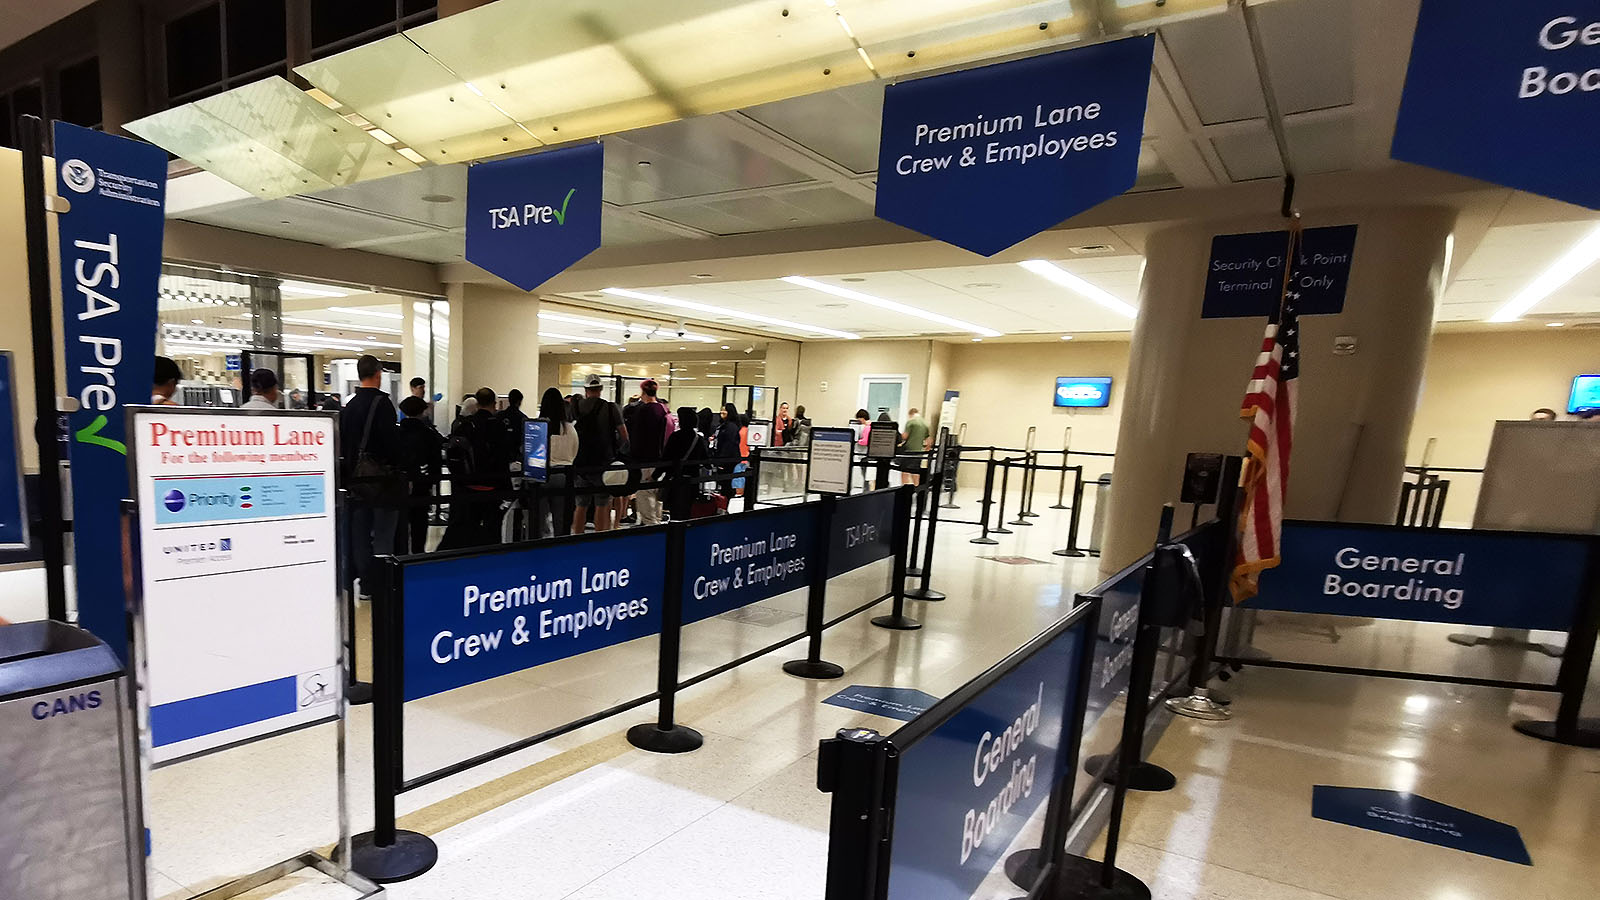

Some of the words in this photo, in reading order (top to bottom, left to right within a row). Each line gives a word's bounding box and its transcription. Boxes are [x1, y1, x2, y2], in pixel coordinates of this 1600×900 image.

[915, 114, 1023, 146] Premium
[1034, 102, 1102, 128] Lane
[896, 155, 953, 176] Crew
[959, 146, 976, 168] &
[985, 130, 1119, 164] Employees
[97, 168, 159, 189] Transportation
[98, 178, 133, 195] Security
[98, 187, 161, 207] Administration
[488, 206, 521, 230] TSA
[1212, 257, 1262, 272] Security
[1312, 252, 1348, 266] Point
[74, 233, 121, 321] TSA
[1218, 278, 1273, 293] Terminal
[1300, 274, 1334, 290] Only
[149, 422, 265, 447] Premium
[272, 424, 326, 446] Lane
[160, 451, 185, 465] For
[188, 451, 208, 464] the
[212, 451, 267, 466] following
[269, 450, 319, 463] members
[188, 492, 237, 508] Priority
[162, 541, 217, 555] UNITED
[710, 537, 767, 567] Premium
[770, 532, 797, 553] Lane
[845, 526, 864, 549] TSA
[1335, 547, 1465, 576] General
[693, 576, 731, 601] Crew
[732, 567, 744, 589] &
[747, 555, 806, 586] Employees
[463, 574, 572, 617] Premium
[581, 567, 630, 594] Lane
[1323, 574, 1465, 610] Boarding
[431, 630, 504, 664] Crew
[511, 615, 530, 645] &
[539, 597, 649, 639] Employees
[31, 690, 103, 721] CANS
[836, 694, 865, 703] Crew
[853, 693, 903, 707] Premium
[973, 681, 1044, 787] General
[960, 754, 1037, 866] Boarding
